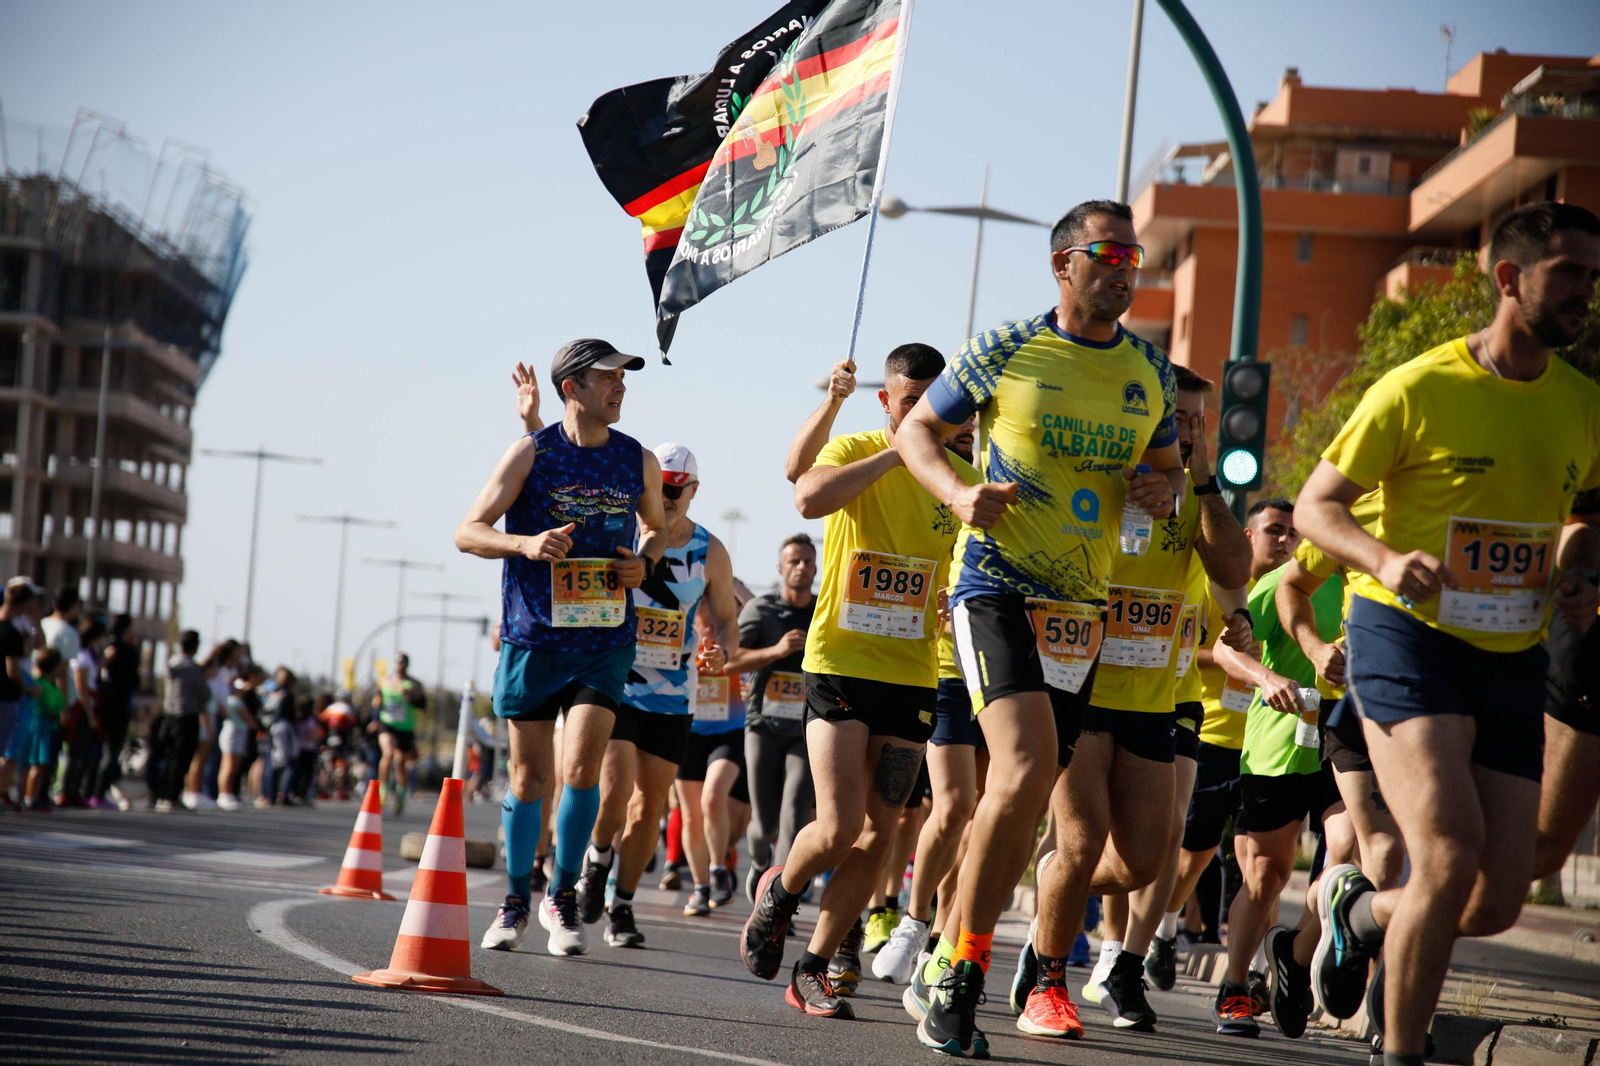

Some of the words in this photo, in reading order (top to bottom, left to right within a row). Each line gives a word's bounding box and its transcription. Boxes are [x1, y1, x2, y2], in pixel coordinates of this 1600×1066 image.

[1041, 413, 1115, 440] CANILLAS
[1119, 426, 1137, 445] DE
[1040, 429, 1134, 462] ALBAIDA
[1060, 523, 1104, 542] axaragua
[1463, 539, 1547, 574] 1991
[561, 571, 619, 591] 1558
[857, 565, 925, 597] 1989
[1491, 575, 1525, 586] JAVIER
[873, 591, 905, 602] MARCOS
[1110, 599, 1174, 626] 1996
[1043, 616, 1092, 647] 590
[1133, 625, 1151, 633] UNAI
[1048, 644, 1072, 654] SALVA
